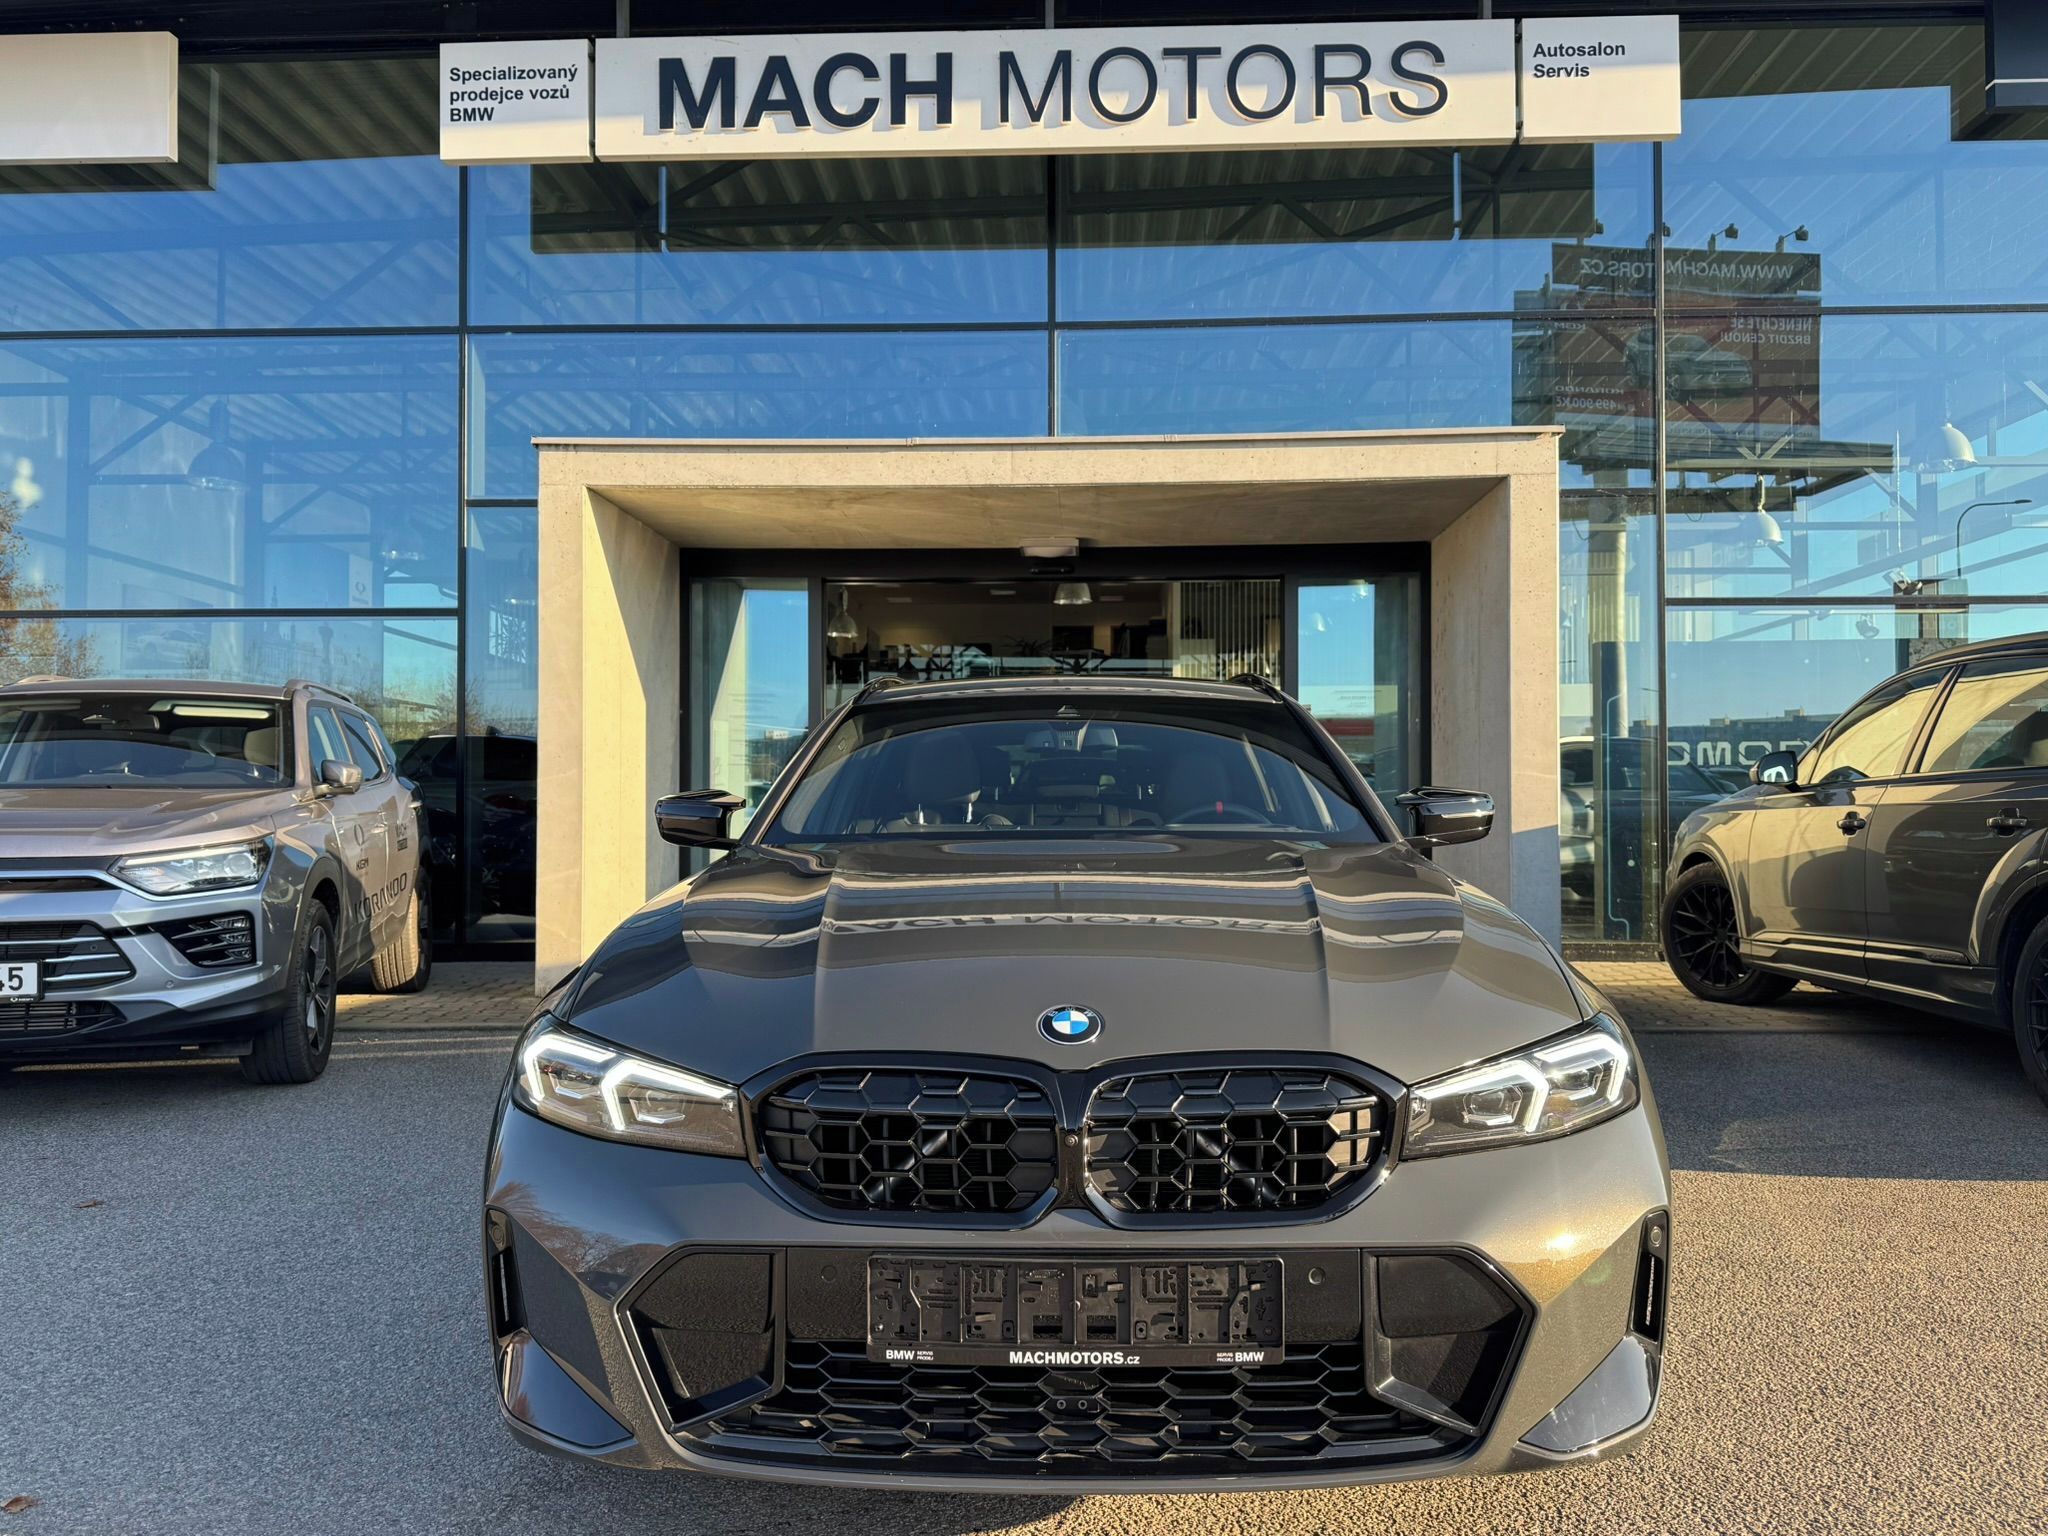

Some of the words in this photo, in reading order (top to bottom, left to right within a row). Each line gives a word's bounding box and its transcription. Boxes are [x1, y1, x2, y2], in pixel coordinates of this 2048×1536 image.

[1532, 41, 1626, 58] Autosalon
[449, 64, 578, 84] Specializovaný
[1532, 62, 1590, 79] Servis
[658, 51, 952, 130] MACH
[999, 40, 1449, 126] MOTORS
[449, 86, 525, 105] prodejce
[529, 84, 570, 100] vozů
[449, 106, 495, 122] BMW
[354, 872, 408, 923] KORANDO
[885, 1349, 915, 1361] BMW
[1009, 1351, 1140, 1365] MACHMOTORS.cz
[1235, 1351, 1265, 1363] BMW
